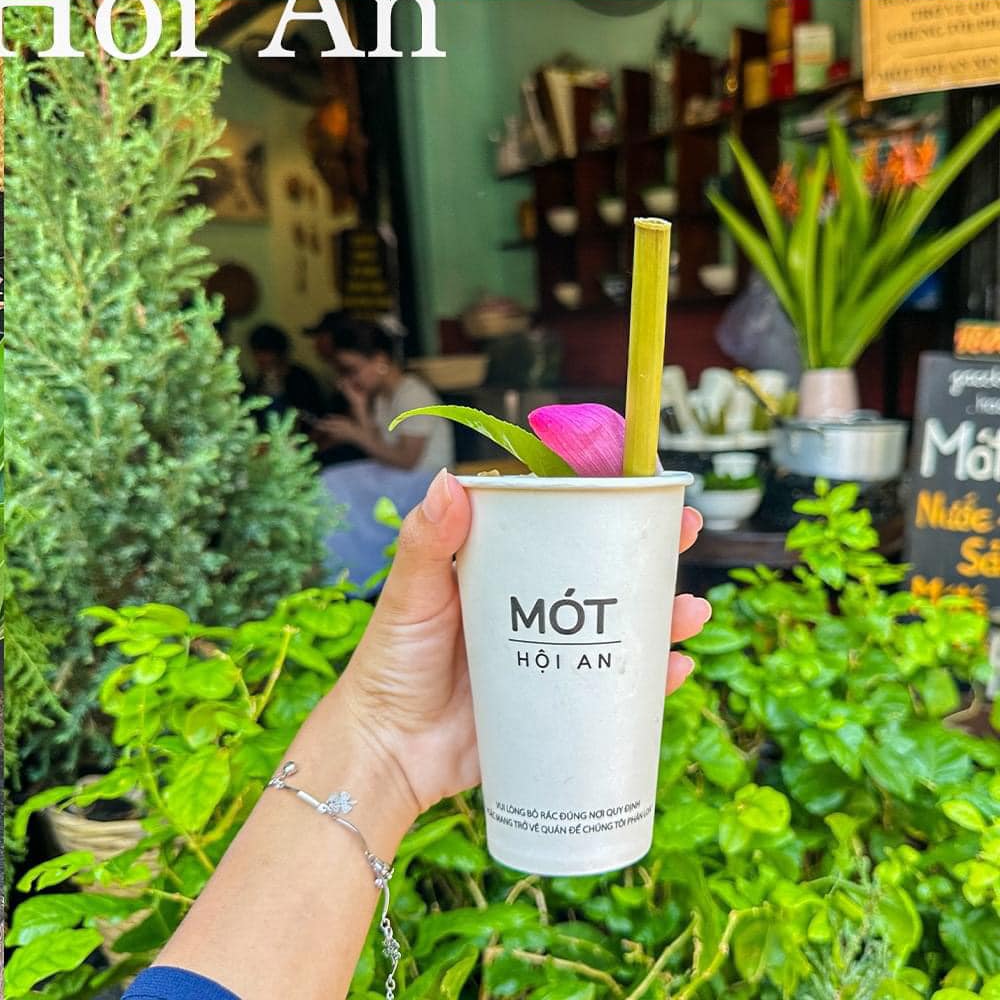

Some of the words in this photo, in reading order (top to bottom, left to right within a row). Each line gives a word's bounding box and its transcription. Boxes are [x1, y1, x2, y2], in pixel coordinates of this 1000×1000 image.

[509, 587, 619, 636] MÓT
[516, 648, 561, 674] HỘI
[576, 652, 612, 670] AN
[540, 809, 559, 820] RÁC
[559, 808, 588, 821] ĐÚNG
[606, 806, 623, 818] QUY
[541, 824, 567, 835] QUÁN
[582, 821, 614, 833] CHÚNG
